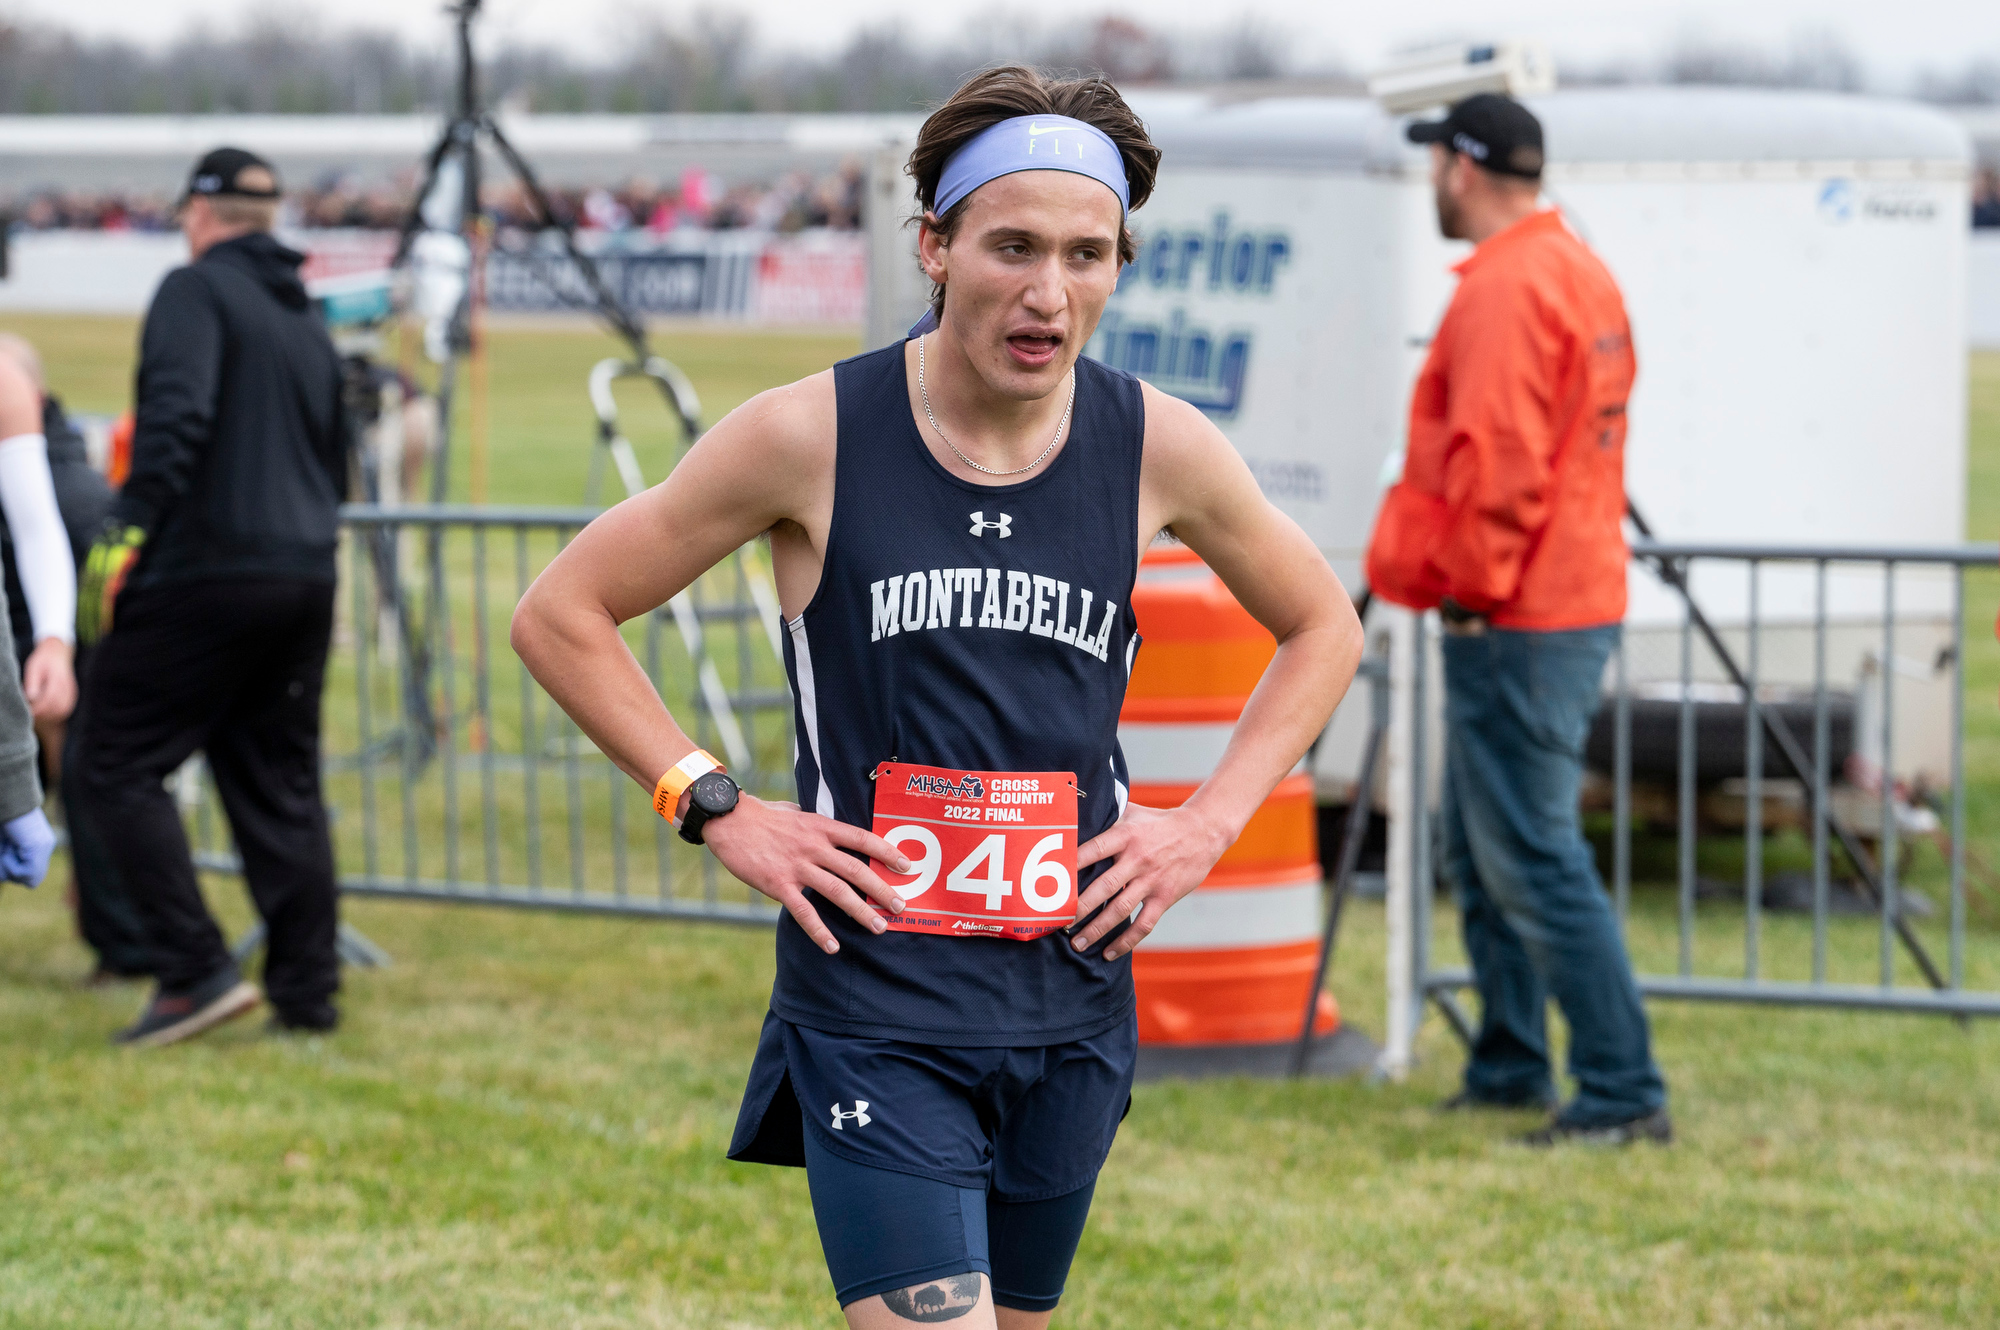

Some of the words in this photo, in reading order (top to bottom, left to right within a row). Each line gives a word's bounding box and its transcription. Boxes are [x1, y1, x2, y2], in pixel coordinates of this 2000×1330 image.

[1028, 138, 1083, 159] FLY
[1098, 308, 1252, 424] iming
[870, 568, 1117, 663] MONTABELLA
[906, 774, 973, 798] MHSAA
[991, 779, 1039, 792] CROSS
[990, 792, 1054, 805] COUNTRY
[943, 805, 980, 821] 2022
[984, 807, 1024, 822] FINAL
[881, 825, 1071, 912] 946
[905, 917, 916, 925] ON
[917, 918, 942, 927] FRONT
[1013, 926, 1034, 934] WEAR
[1034, 926, 1043, 934] ON
